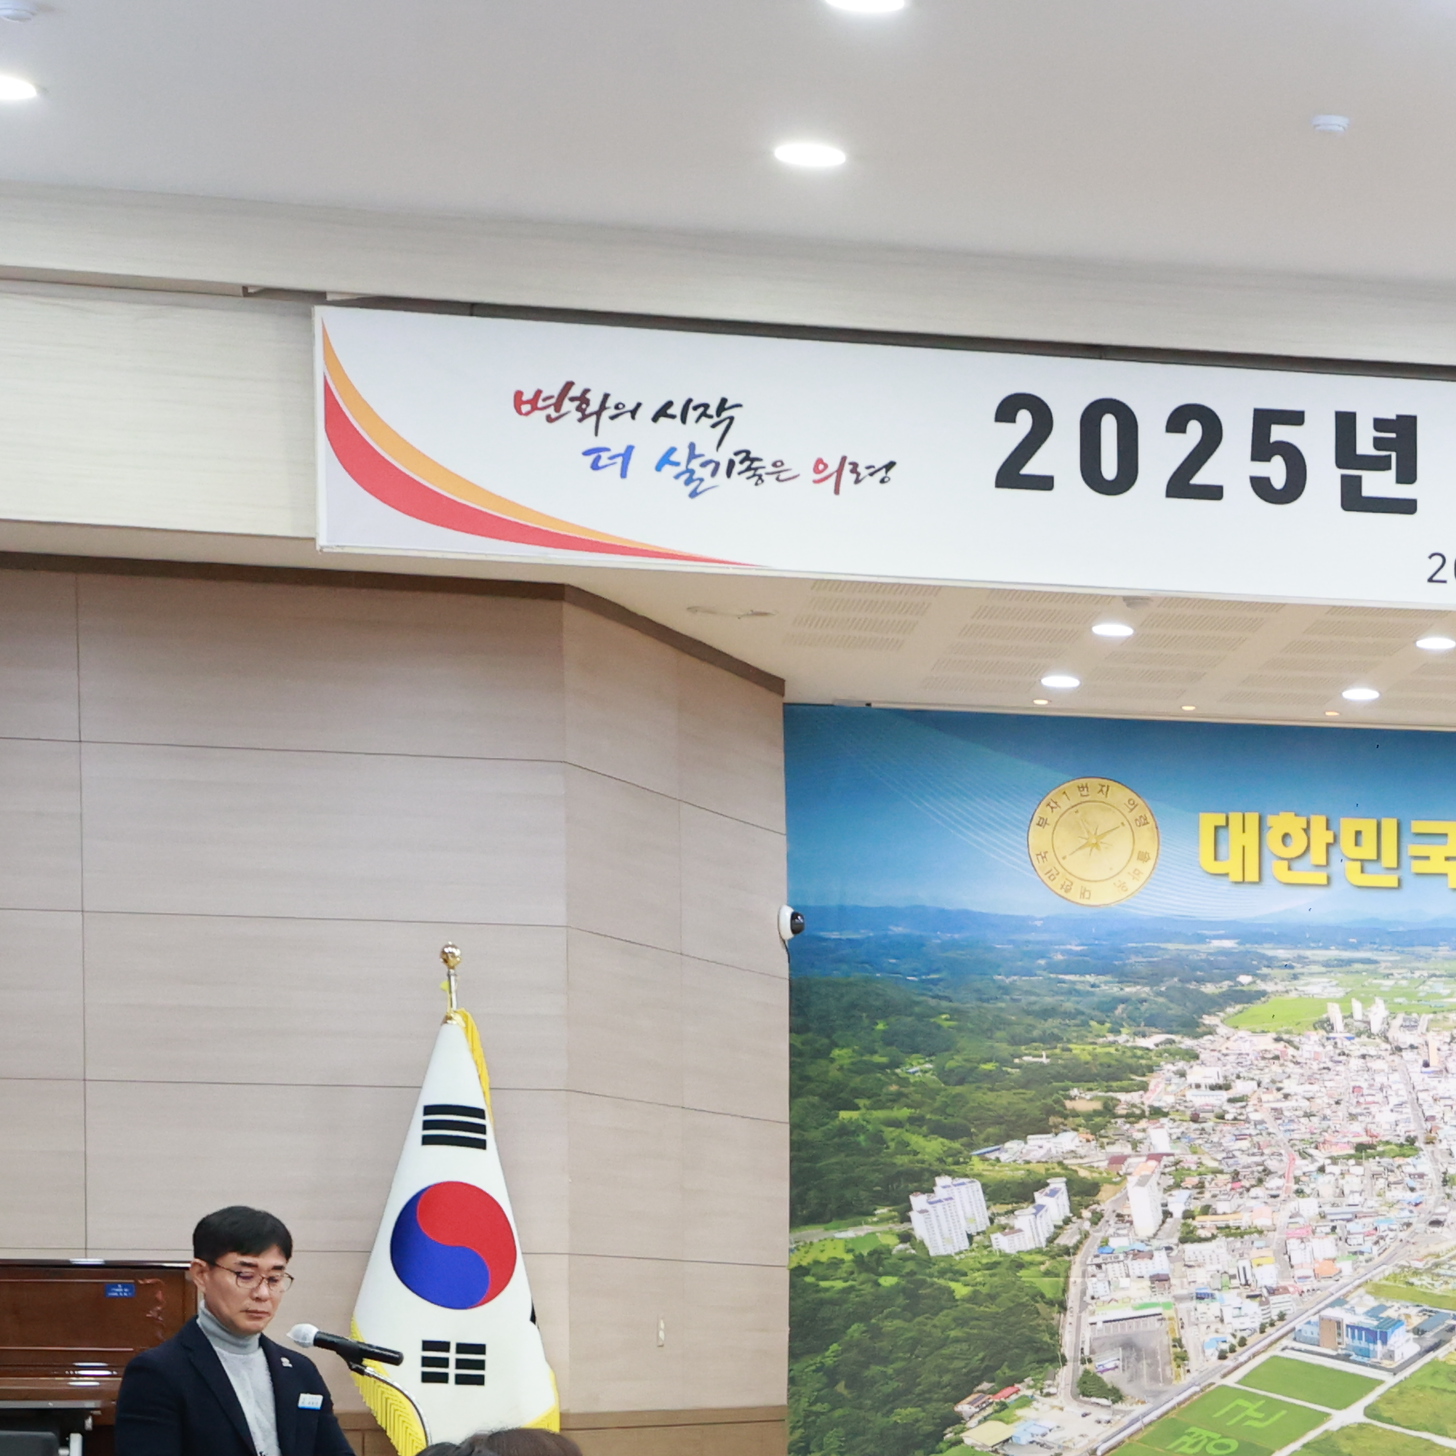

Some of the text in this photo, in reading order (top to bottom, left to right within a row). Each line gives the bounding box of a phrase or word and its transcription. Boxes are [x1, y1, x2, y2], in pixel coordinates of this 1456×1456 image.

[513, 381, 744, 451] 변화의 시작
[581, 441, 897, 499] 더 살기좋은 의령
[994, 392, 1419, 515] 2025년
